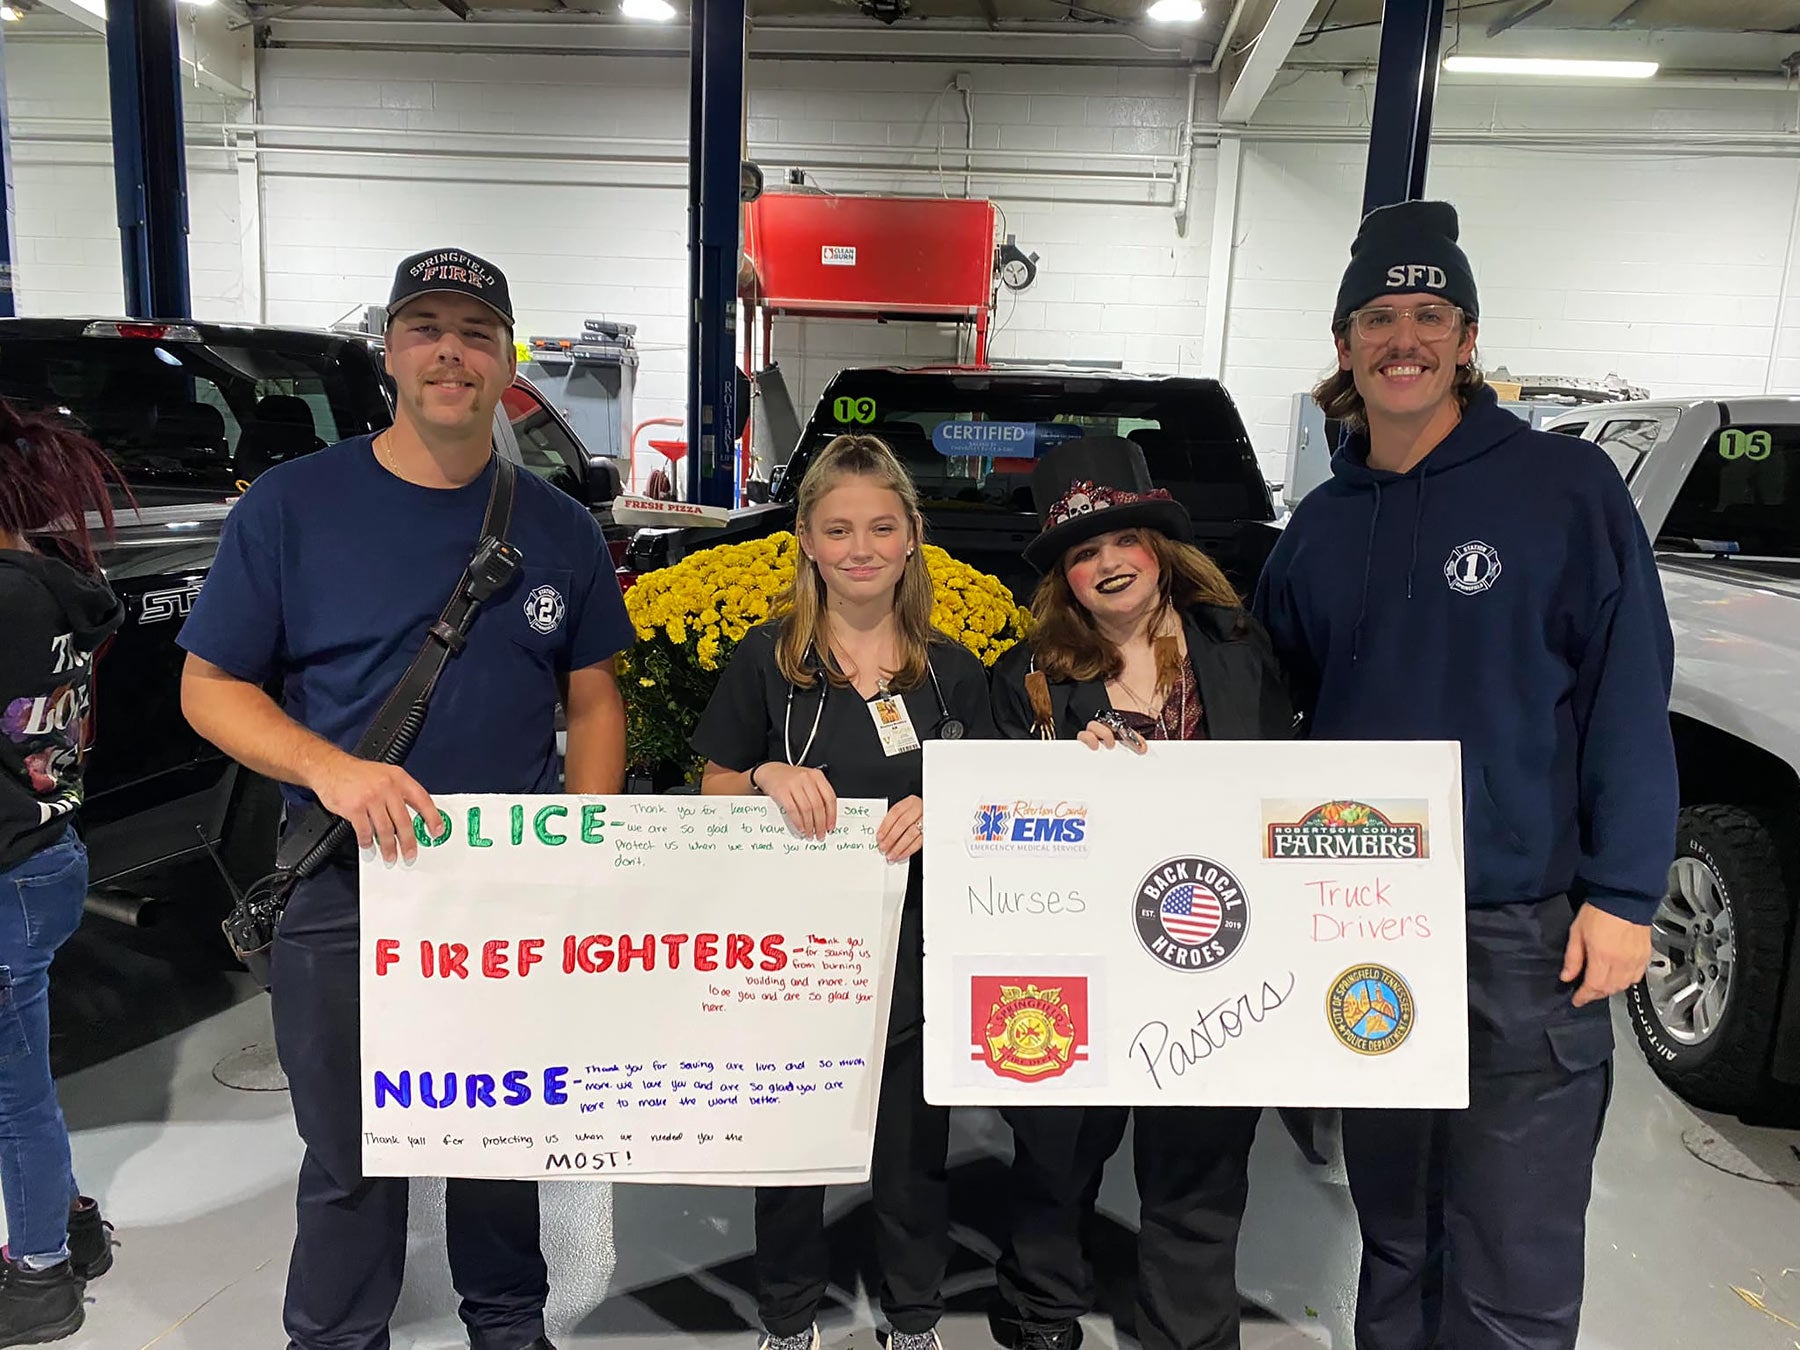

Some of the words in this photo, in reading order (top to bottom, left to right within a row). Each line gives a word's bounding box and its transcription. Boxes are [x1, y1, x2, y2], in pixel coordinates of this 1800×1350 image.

[410, 252, 495, 286] SPRINGFIELD
[423, 265, 482, 288] FIRE
[1386, 265, 1447, 288] SFD
[723, 380, 733, 454] ROTARY
[837, 398, 875, 421] 19
[942, 424, 1026, 441] CERTIFIED
[1723, 431, 1769, 458] 15
[624, 500, 664, 511] FRESH
[667, 504, 703, 514] PIZZA
[1463, 553, 1479, 582] 1
[539, 597, 553, 622] 2
[630, 803, 667, 815] Thank
[677, 805, 696, 820] you
[701, 804, 717, 815] for
[730, 802, 767, 817] keeping
[844, 805, 870, 817] safe
[1055, 800, 1088, 818] County
[648, 824, 668, 833] are
[681, 823, 694, 833] so
[707, 823, 728, 837] glad
[741, 822, 753, 833] to
[759, 823, 785, 834] have
[861, 824, 875, 835] to
[1011, 818, 1085, 842] EMS
[665, 841, 679, 850] us
[689, 840, 716, 850] when
[728, 843, 743, 851] we
[783, 843, 799, 854] you
[837, 842, 864, 850] when
[1052, 844, 1088, 852] SERVICES
[1274, 834, 1417, 858] FARMERS
[968, 875, 1086, 916] Nurses
[1143, 862, 1189, 900] BACK
[1195, 863, 1242, 910] LOCAL
[1304, 877, 1393, 908] Truck
[1141, 909, 1156, 918] EST.
[1224, 920, 1242, 929] 2019
[1310, 913, 1431, 942] Drivers
[806, 934, 840, 945] Thank
[847, 937, 864, 951] you
[1151, 935, 1226, 966] HEROES
[805, 946, 818, 957] for
[824, 949, 854, 962] saving
[859, 949, 871, 958] us
[792, 958, 815, 969] from
[822, 961, 862, 974] burning
[745, 976, 786, 990] building
[791, 977, 809, 986] and
[1336, 969, 1380, 996] SPRINGFIELD
[1380, 972, 1410, 1012] TENNESSEE
[737, 991, 755, 1002] you
[761, 992, 777, 1001] and
[784, 992, 800, 1001] are
[808, 992, 821, 1001] so
[828, 991, 850, 1003] glad
[1332, 994, 1343, 1006] OF
[996, 999, 1064, 1022] SPRINGFIELD
[1332, 1007, 1343, 1024] CITY
[1129, 971, 1295, 1090] Pastors
[1342, 1029, 1367, 1050] POLICE
[1368, 1019, 1408, 1050] DEPARTMENT
[585, 1064, 619, 1074] Thank
[625, 1063, 643, 1077] you
[653, 1060, 667, 1071] for
[680, 1061, 714, 1073] saving
[726, 1063, 744, 1071] are
[756, 1062, 776, 1071] lives
[785, 1061, 805, 1070] and
[819, 1060, 833, 1068] so
[839, 1058, 865, 1067] much
[643, 1080, 661, 1089] love
[671, 1080, 686, 1092] you
[693, 1080, 713, 1090] and
[720, 1083, 739, 1091] are
[750, 1082, 763, 1091] so
[769, 1081, 793, 1093] glad
[796, 1083, 816, 1095] you
[824, 1081, 844, 1091] are
[580, 1101, 605, 1113] here
[617, 1099, 629, 1108] to
[639, 1098, 667, 1107] make
[679, 1097, 696, 1105] the
[708, 1095, 738, 1107] world
[363, 1132, 400, 1145] Thank
[443, 1134, 464, 1145] for
[482, 1135, 534, 1149] protecting
[545, 1134, 559, 1143] us
[575, 1132, 604, 1141] when
[620, 1133, 632, 1141] we
[650, 1132, 683, 1141] needed
[697, 1133, 714, 1144] you
[725, 1133, 744, 1142] the
[545, 1150, 633, 1170] MOST!
